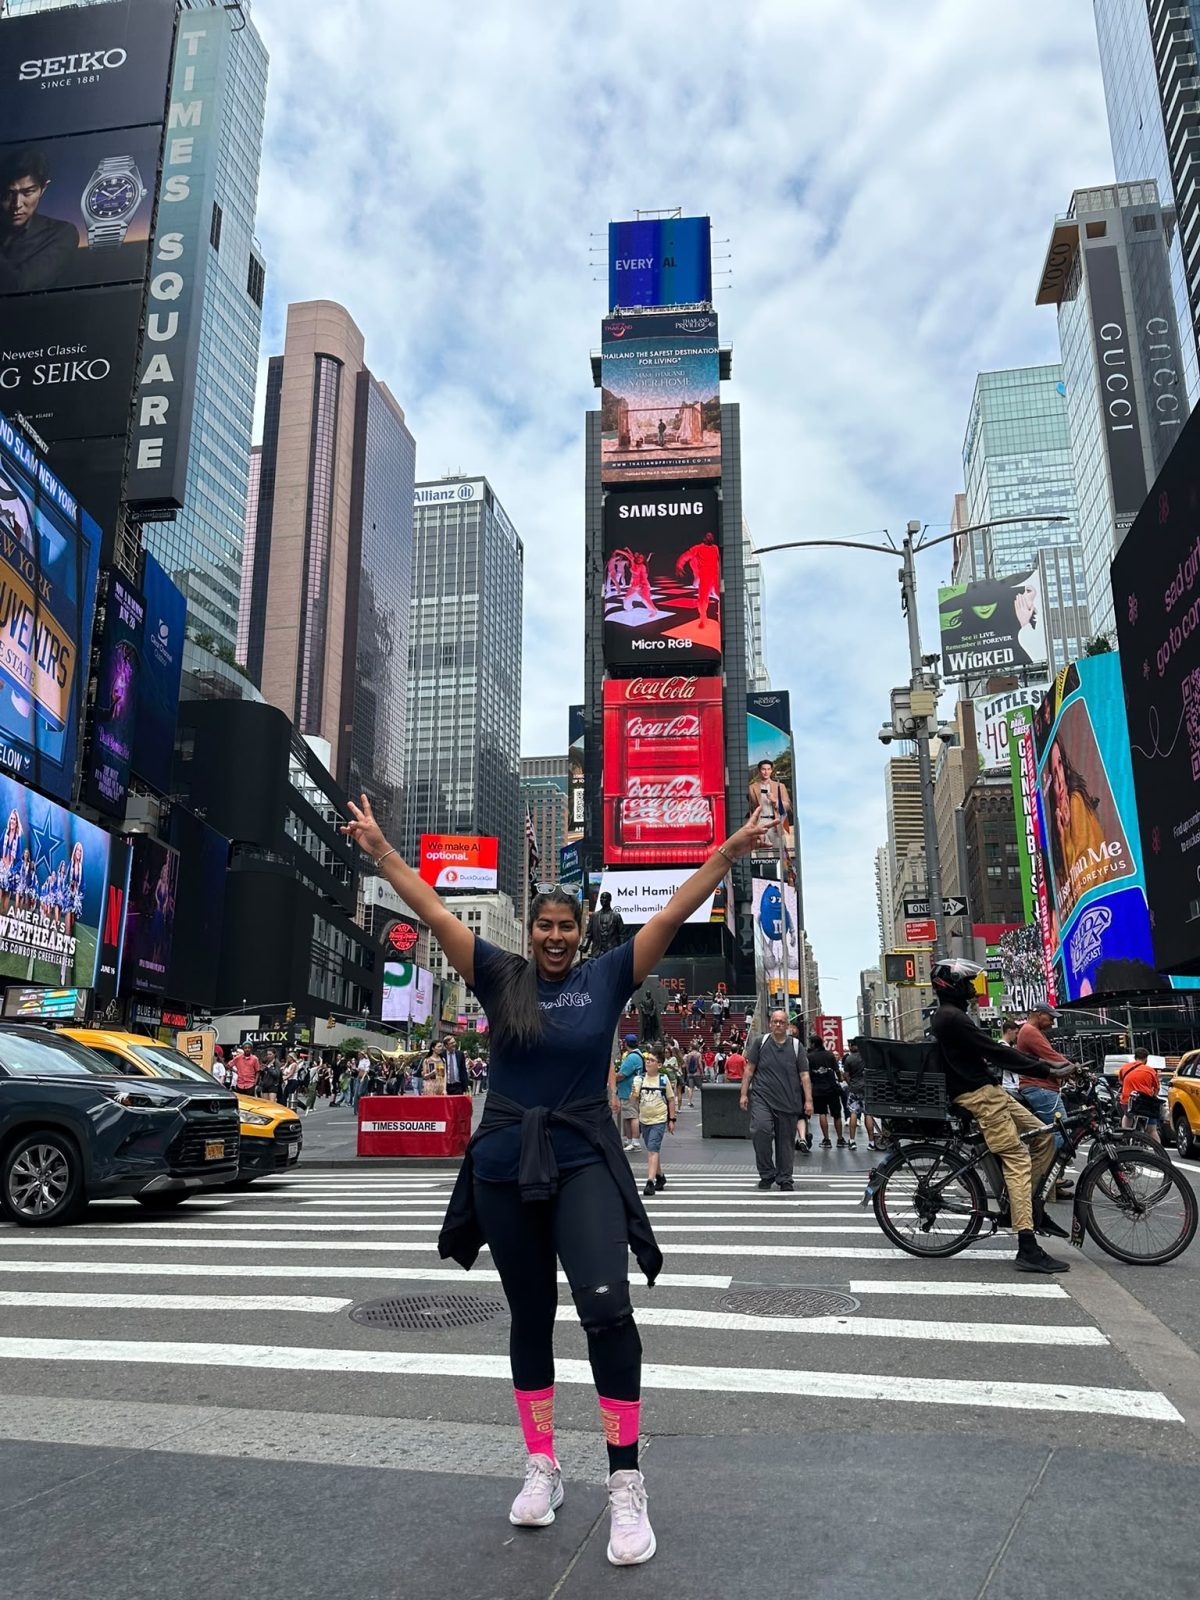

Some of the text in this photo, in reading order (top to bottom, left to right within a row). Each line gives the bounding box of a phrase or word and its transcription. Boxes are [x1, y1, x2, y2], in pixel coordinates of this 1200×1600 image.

[18, 47, 128, 81] SEIKO
[40, 74, 101, 90] SINCE 1881
[163, 30, 207, 202] TIMES
[615, 258, 654, 270] EVERY
[2, 343, 88, 361] Newest Classic
[136, 232, 185, 469] SQUARE
[601, 352, 635, 360] THAILAND
[650, 349, 674, 357] SAFEST
[675, 347, 720, 356] DESTINATION
[32, 358, 111, 386] SEIKO
[660, 377, 691, 387] HOME
[1100, 322, 1134, 432] GUCCI
[14, 436, 39, 476] SLAM
[38, 463, 58, 497] NEW
[57, 485, 78, 521] YORK
[413, 489, 455, 502] Allianz
[619, 502, 704, 518] SAMSUNG
[0, 529, 17, 558] W
[1164, 563, 1184, 613] sad
[631, 638, 693, 650] Micro RGB
[945, 641, 976, 651] Remember
[1156, 641, 1170, 677] go
[1169, 627, 1181, 653] to
[6, 648, 36, 687] STATE
[984, 691, 1029, 720] LITTLE
[1017, 739, 1038, 894] CANNABIS
[427, 841, 443, 850] We
[444, 843, 470, 851] make
[1087, 841, 1122, 865] Me
[617, 885, 680, 897] Mel Hamilt
[6, 905, 66, 933] AMERICA'S
[613, 904, 666, 913] @melhamilt
[0, 914, 77, 955] WEETHEARTS
[10, 943, 37, 959] COWBOYS
[37, 950, 75, 968] CHEERLEADERS
[136, 1004, 151, 1017] BLUE
[246, 1031, 288, 1042] KLIKTIX
[822, 1019, 839, 1051] tkts
